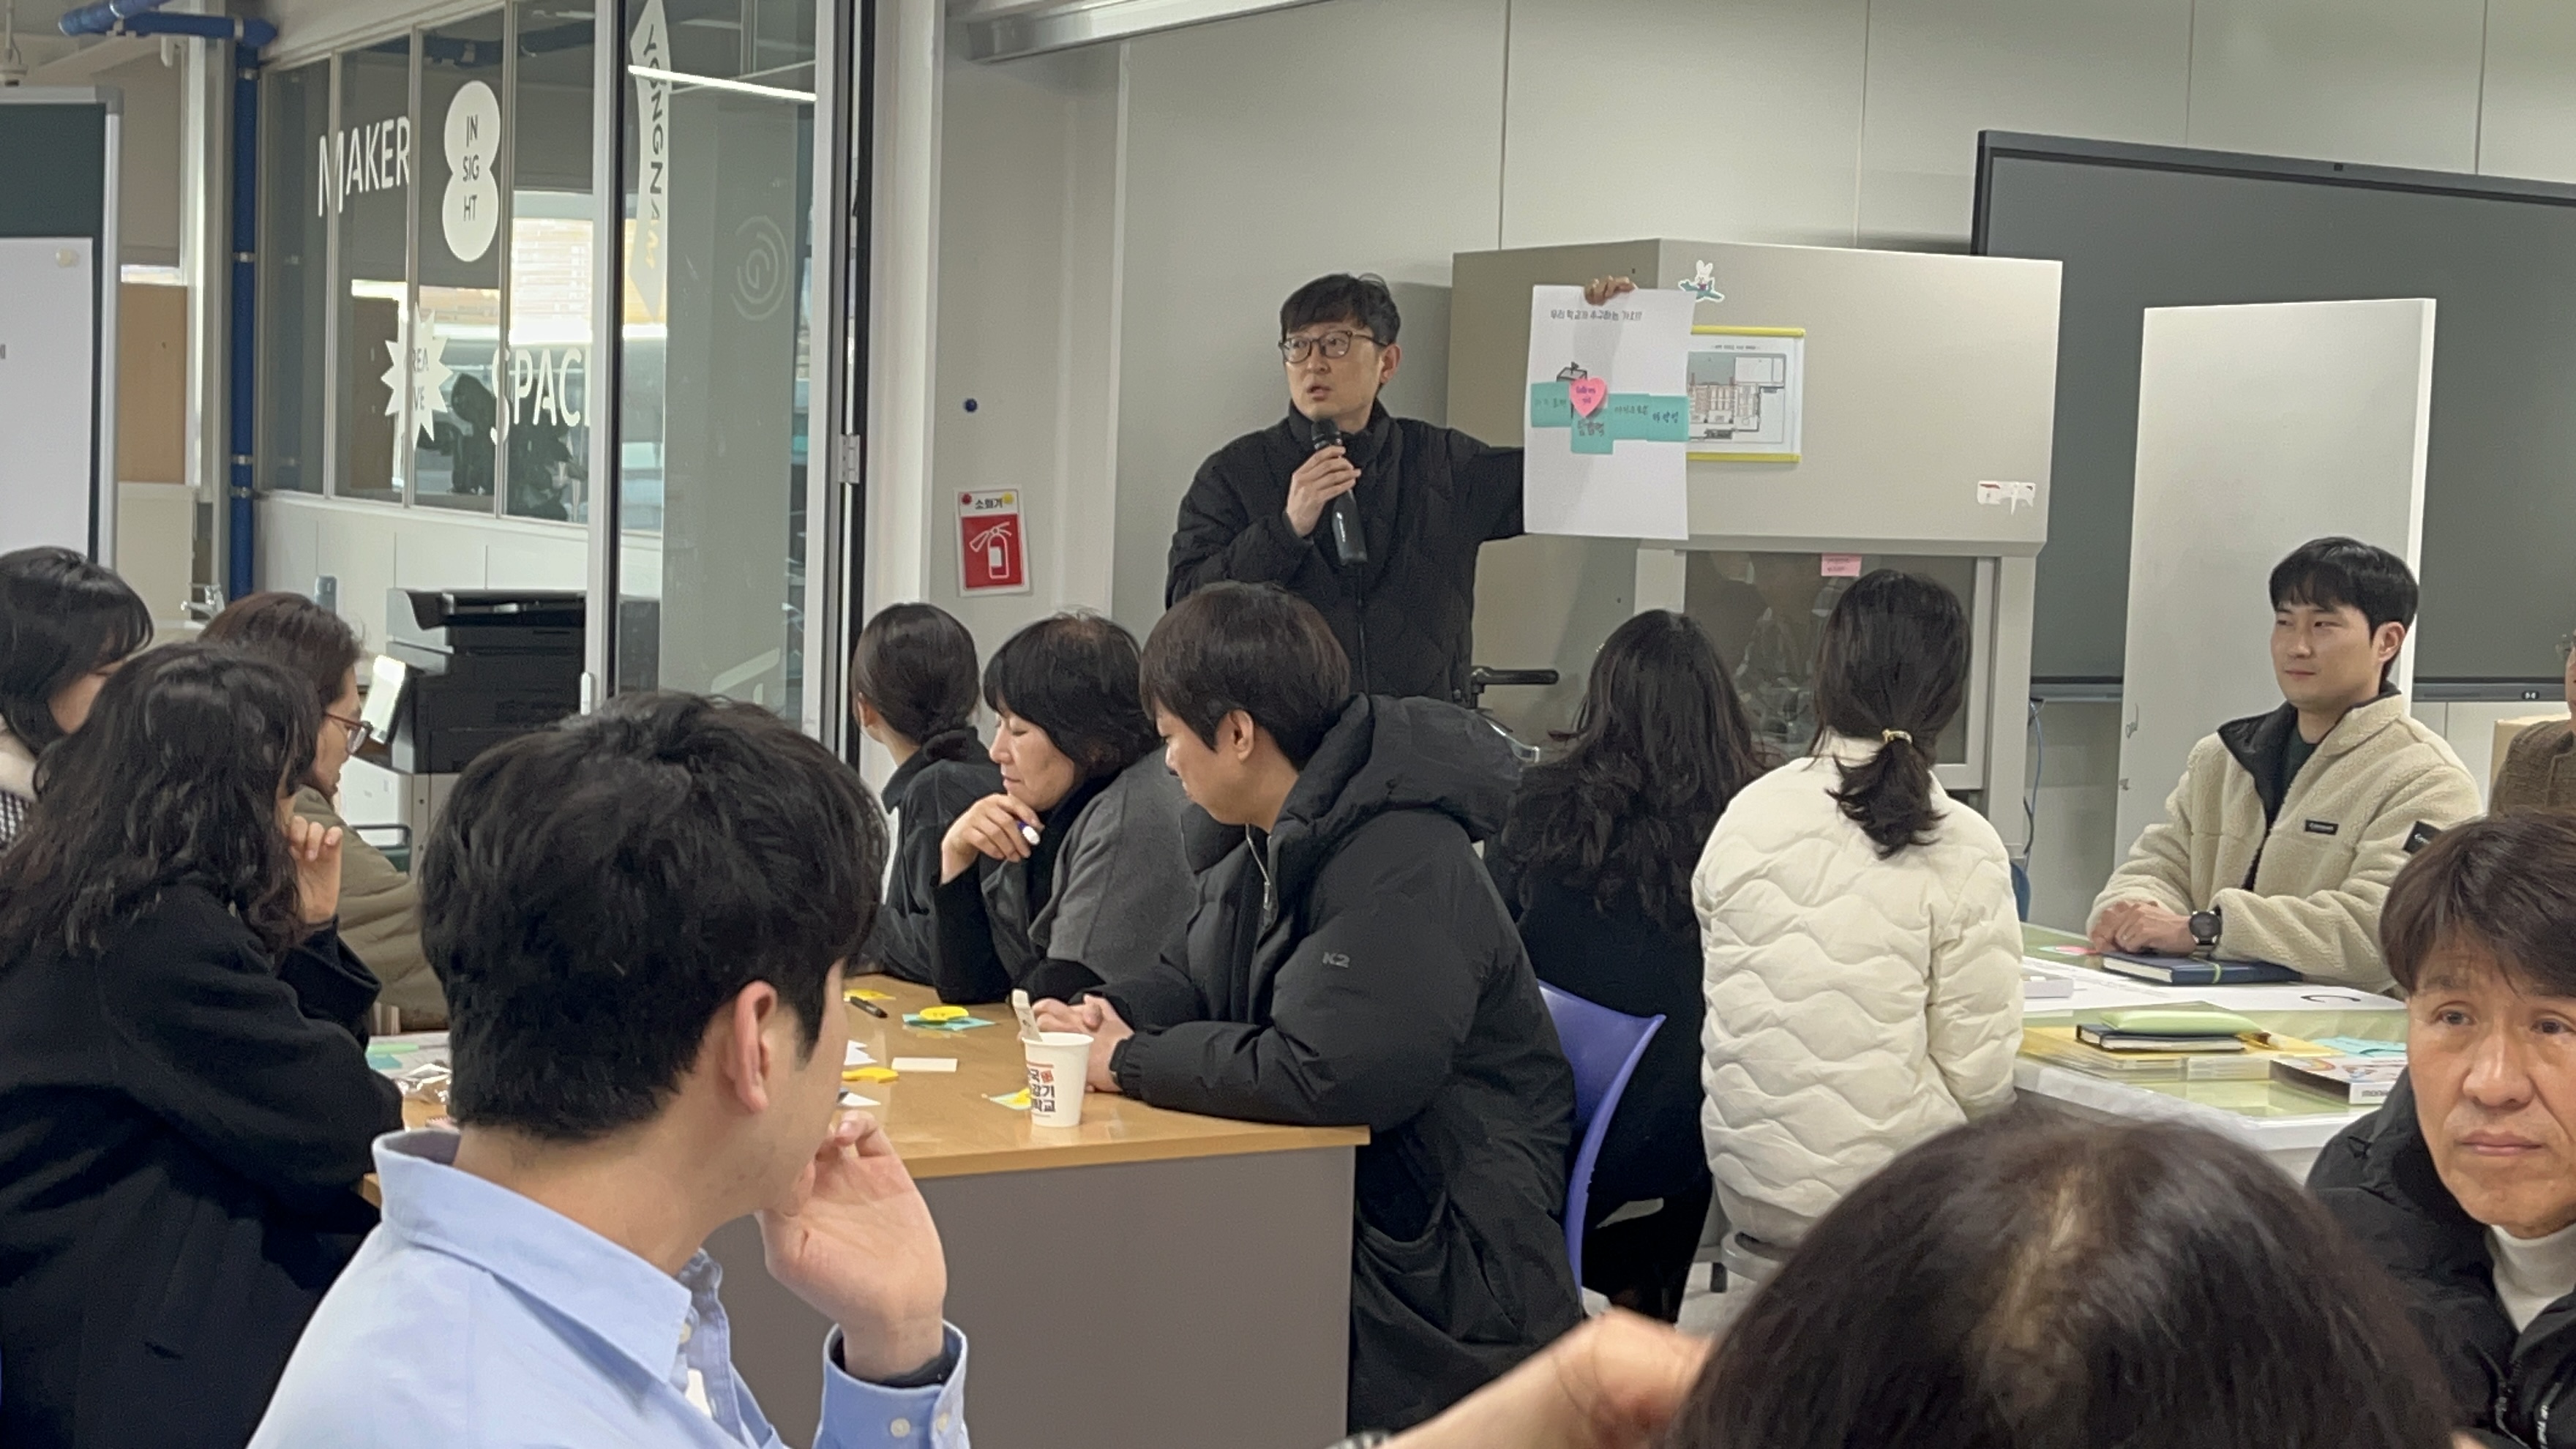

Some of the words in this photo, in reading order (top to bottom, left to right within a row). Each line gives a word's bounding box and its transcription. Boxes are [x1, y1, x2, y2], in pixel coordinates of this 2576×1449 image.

[466, 113, 479, 148] IN
[318, 115, 411, 217] MAKER
[463, 154, 480, 182] SIG
[463, 194, 478, 222] HT
[490, 346, 590, 446] SPAC
[975, 498, 1003, 510] 소화기
[1322, 951, 1350, 968] K2
